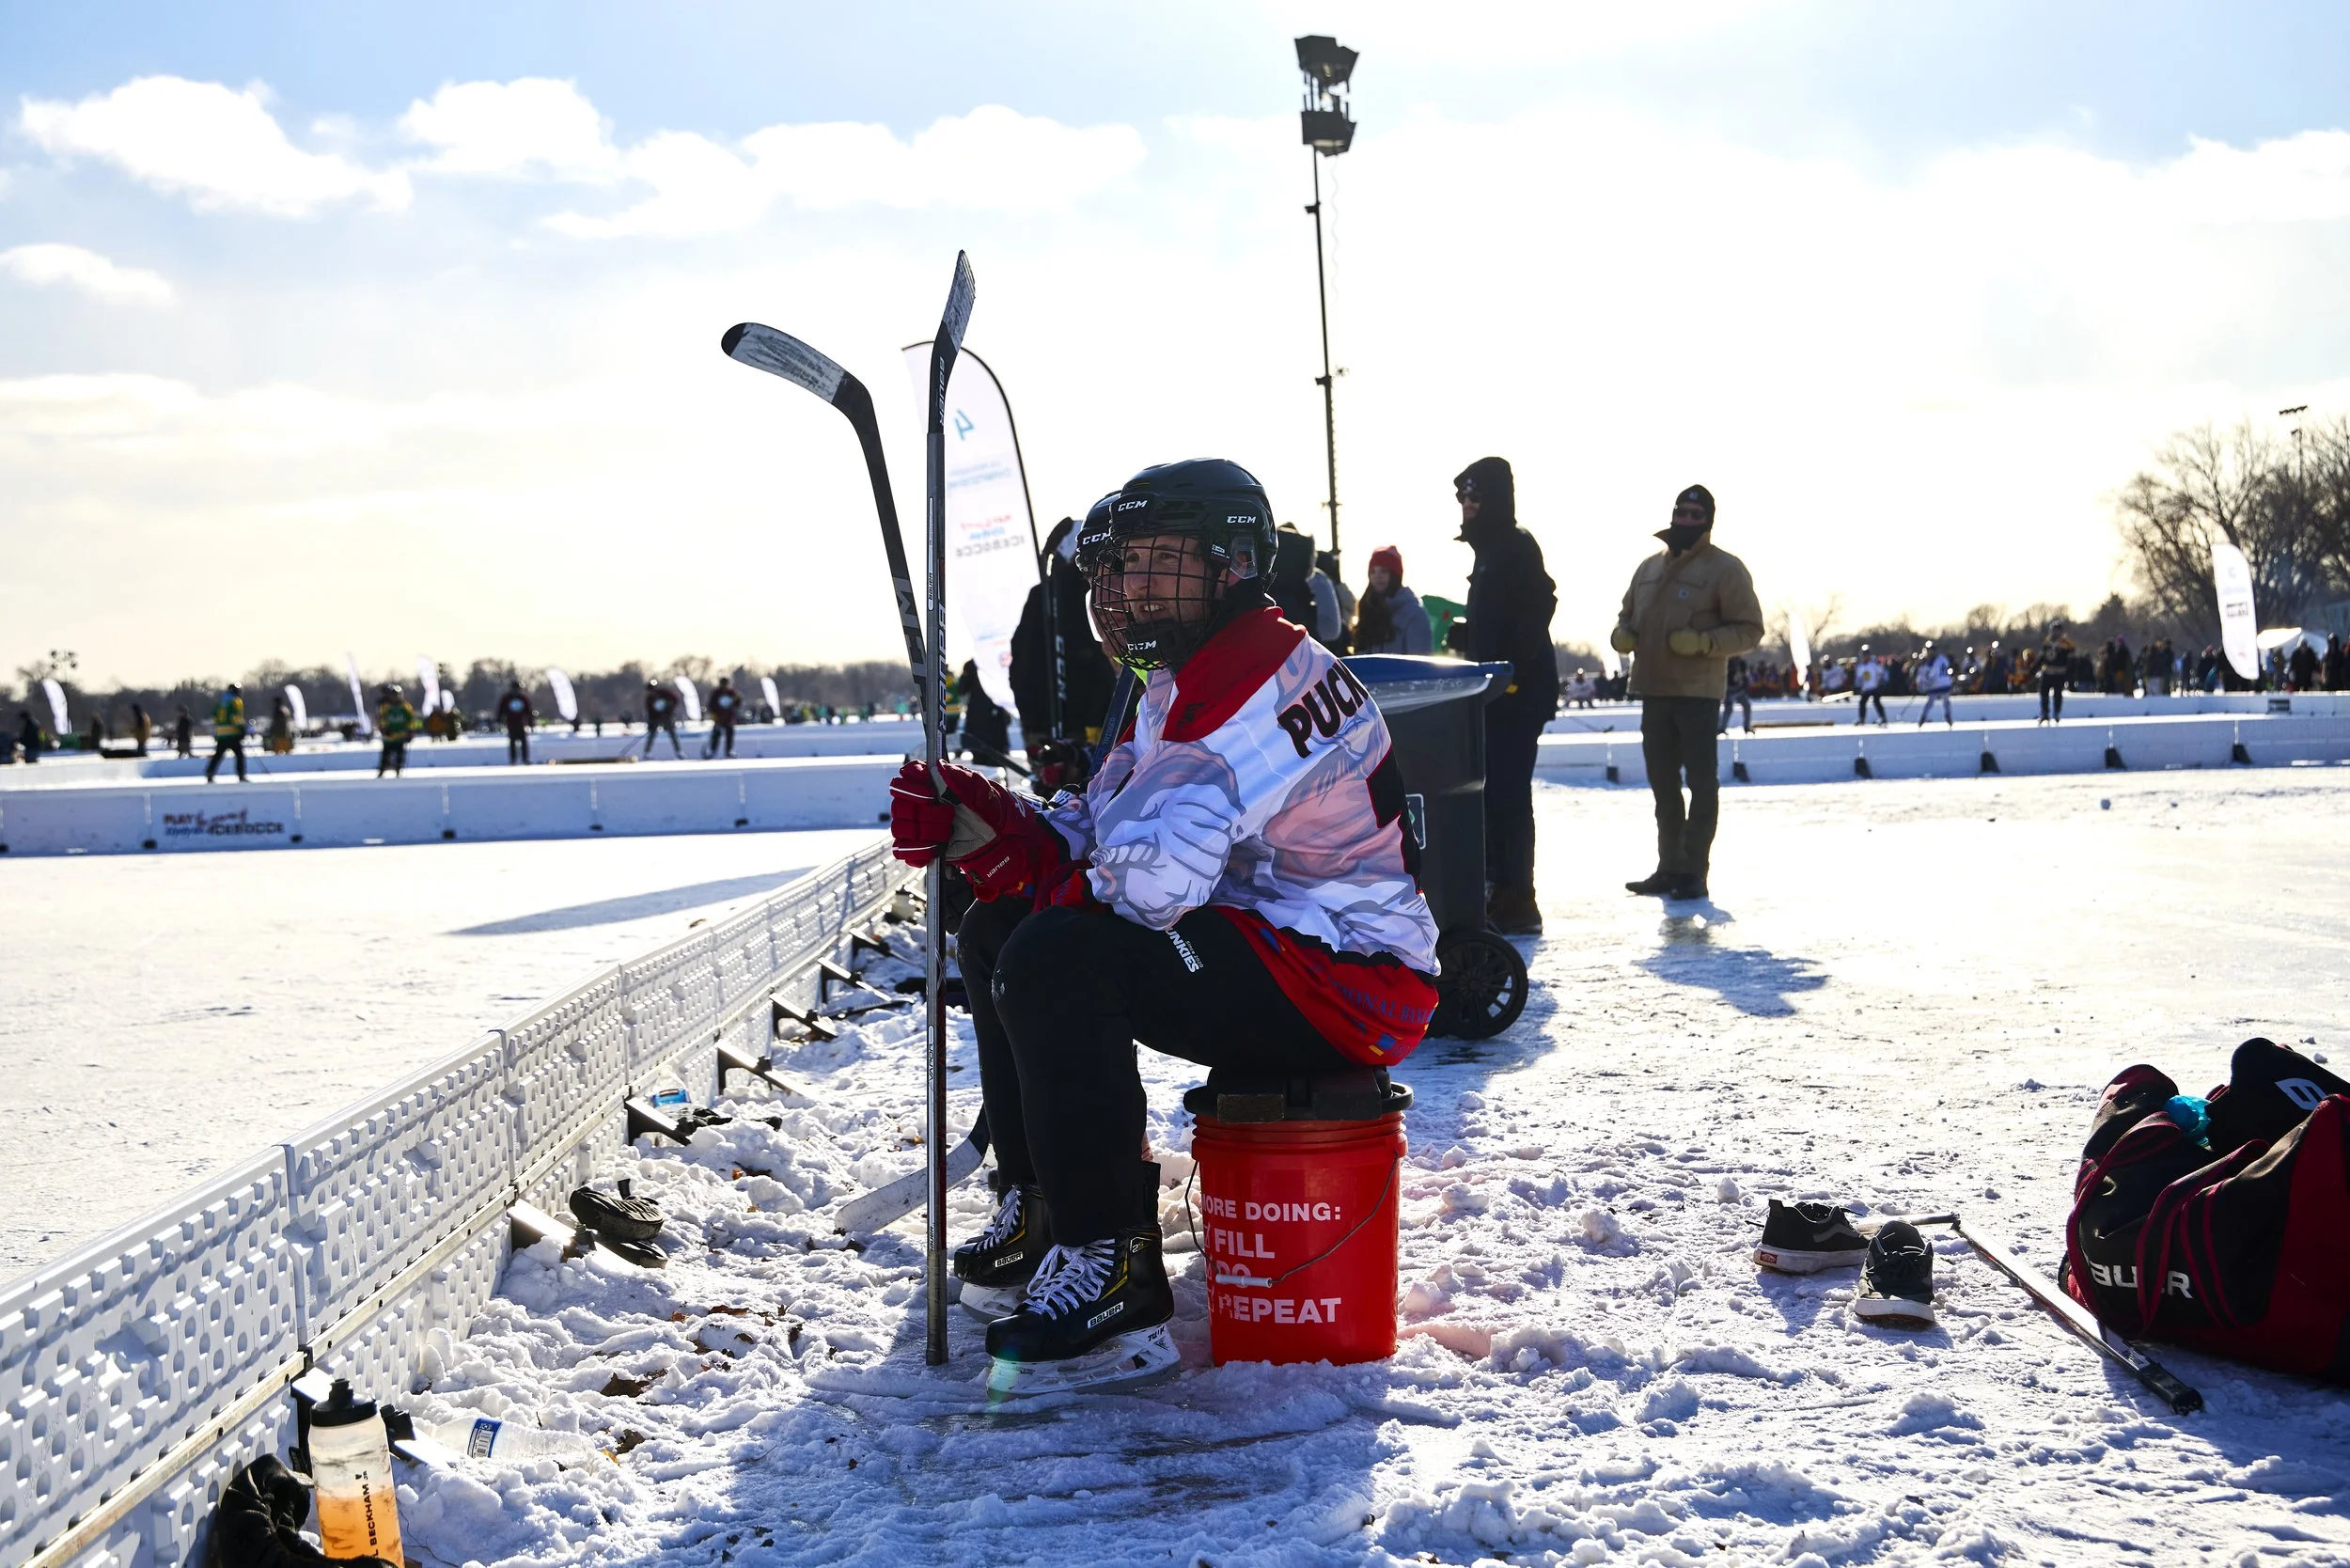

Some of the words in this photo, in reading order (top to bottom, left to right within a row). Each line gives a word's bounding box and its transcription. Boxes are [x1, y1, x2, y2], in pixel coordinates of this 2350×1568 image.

[1117, 499, 1148, 512] CCM
[1226, 515, 1257, 525] CCM
[1082, 532, 1110, 545] CCM
[1127, 640, 1157, 651] CCM
[1277, 658, 1370, 760] PUCK
[986, 855, 1011, 879] BAUER
[1166, 927, 1199, 973] UNKIES
[1245, 1201, 1341, 1222] DOING:
[1214, 1228, 1276, 1259] FILL
[996, 1253, 1022, 1266] BAUER
[1215, 1260, 1252, 1289] DO
[2089, 1260, 2194, 1299] AUR
[1089, 1304, 1123, 1328] BAUER
[1218, 1292, 1342, 1324] REPEAT
[362, 1483, 378, 1546] BECKHAM
